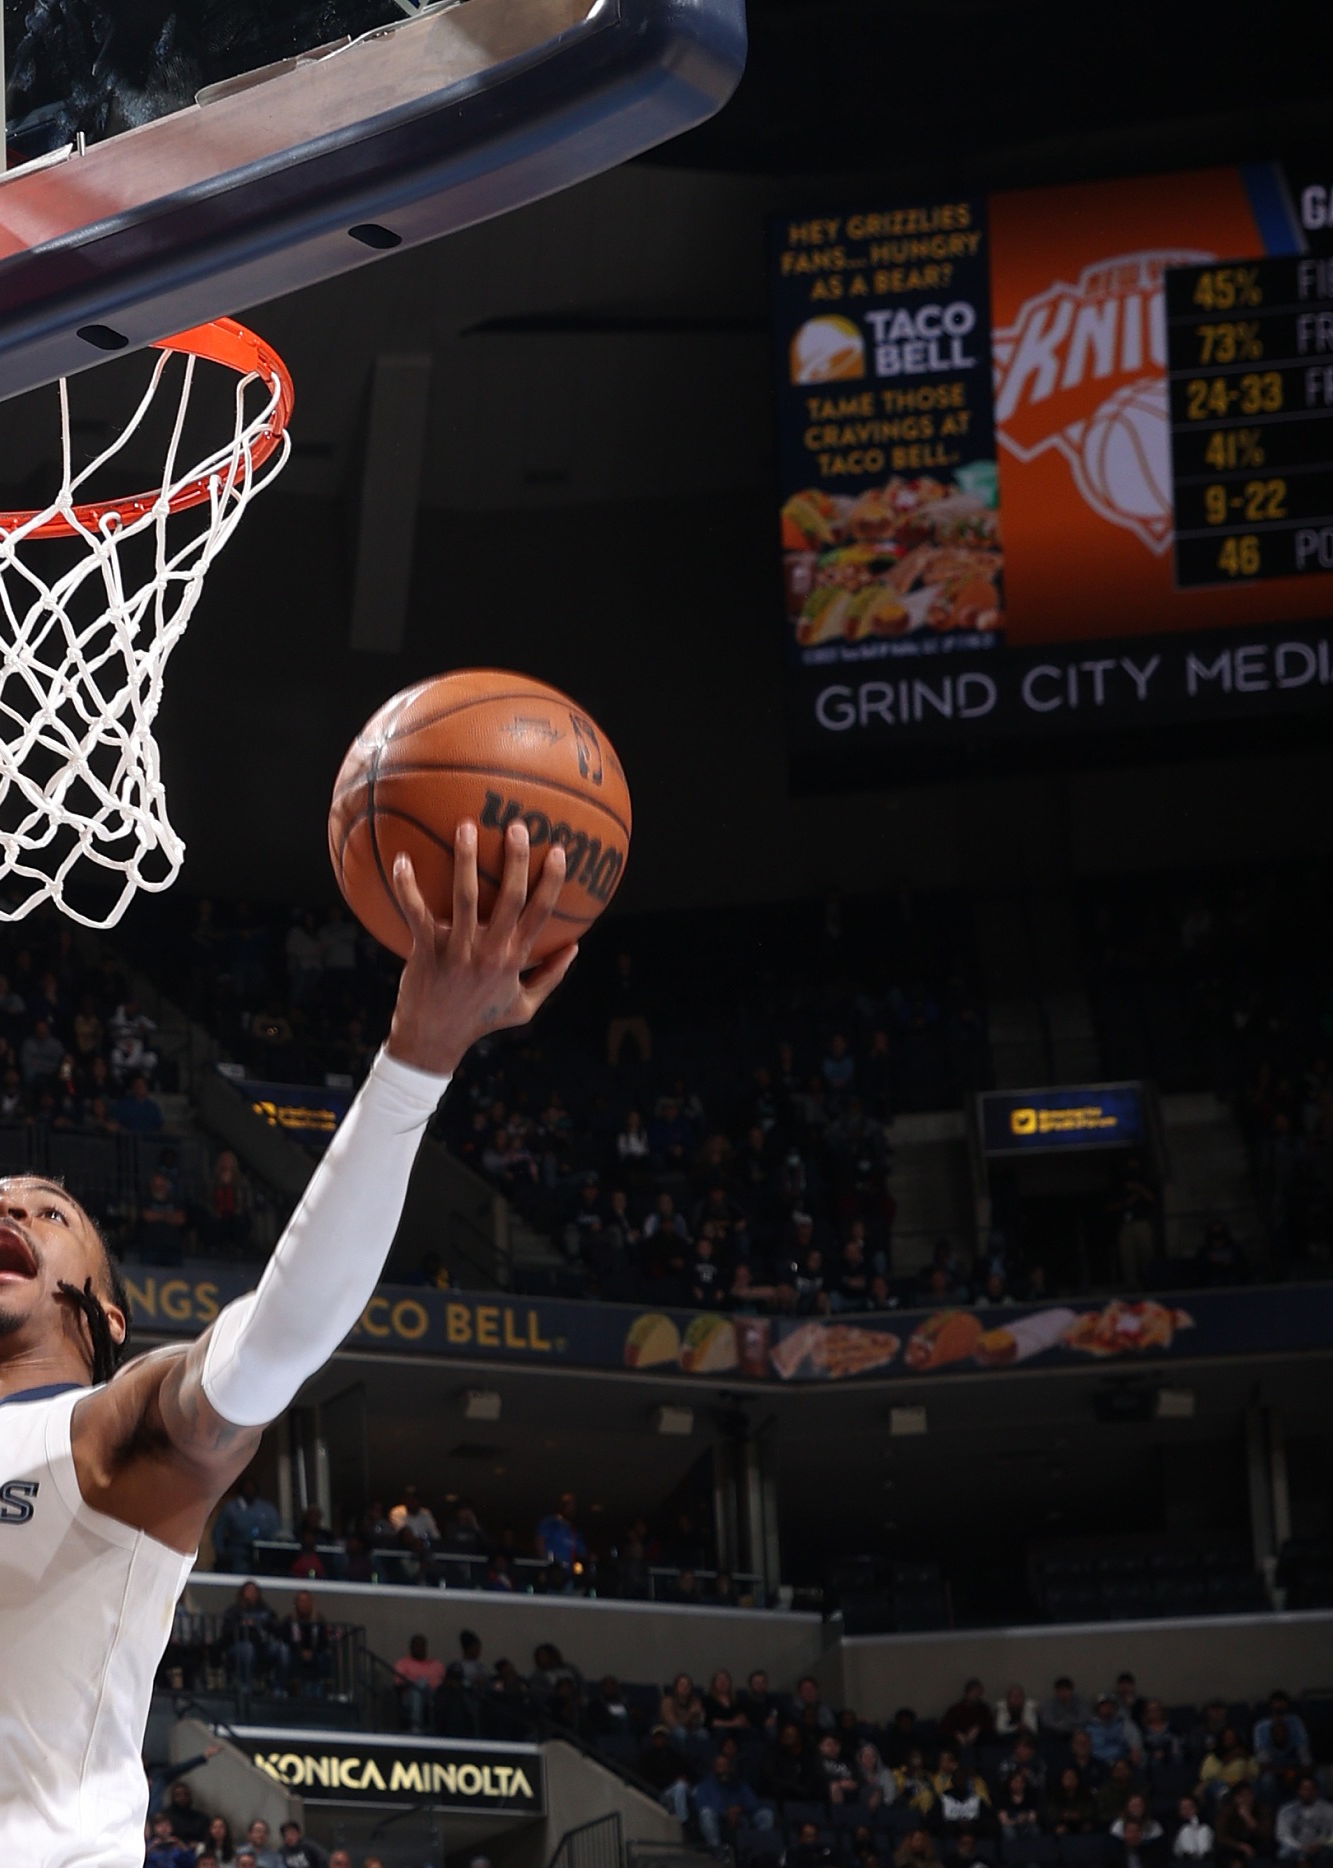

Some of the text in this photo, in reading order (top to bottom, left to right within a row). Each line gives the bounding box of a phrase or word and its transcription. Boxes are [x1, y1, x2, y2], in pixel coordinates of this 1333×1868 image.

[788, 202, 971, 248] HEY GRIZZLIES
[869, 230, 982, 267] HUNGRY
[810, 262, 954, 301] AS A BEAR?
[1192, 266, 1263, 311] 45%
[865, 301, 978, 344] TACO
[1195, 319, 1264, 366] 73%
[874, 337, 978, 378] BELL
[806, 381, 966, 422] TAME THOSE
[1185, 369, 1284, 421] 24-33
[803, 409, 973, 451] CRAVINGS AT
[1204, 427, 1266, 471] 41%
[817, 447, 885, 479] TACO
[1203, 476, 1289, 526] 9-22
[1216, 533, 1263, 577] 46
[814, 638, 1333, 732] GRIND CITY MEDI
[255, 1751, 535, 1799] KONICA MINOLTA
